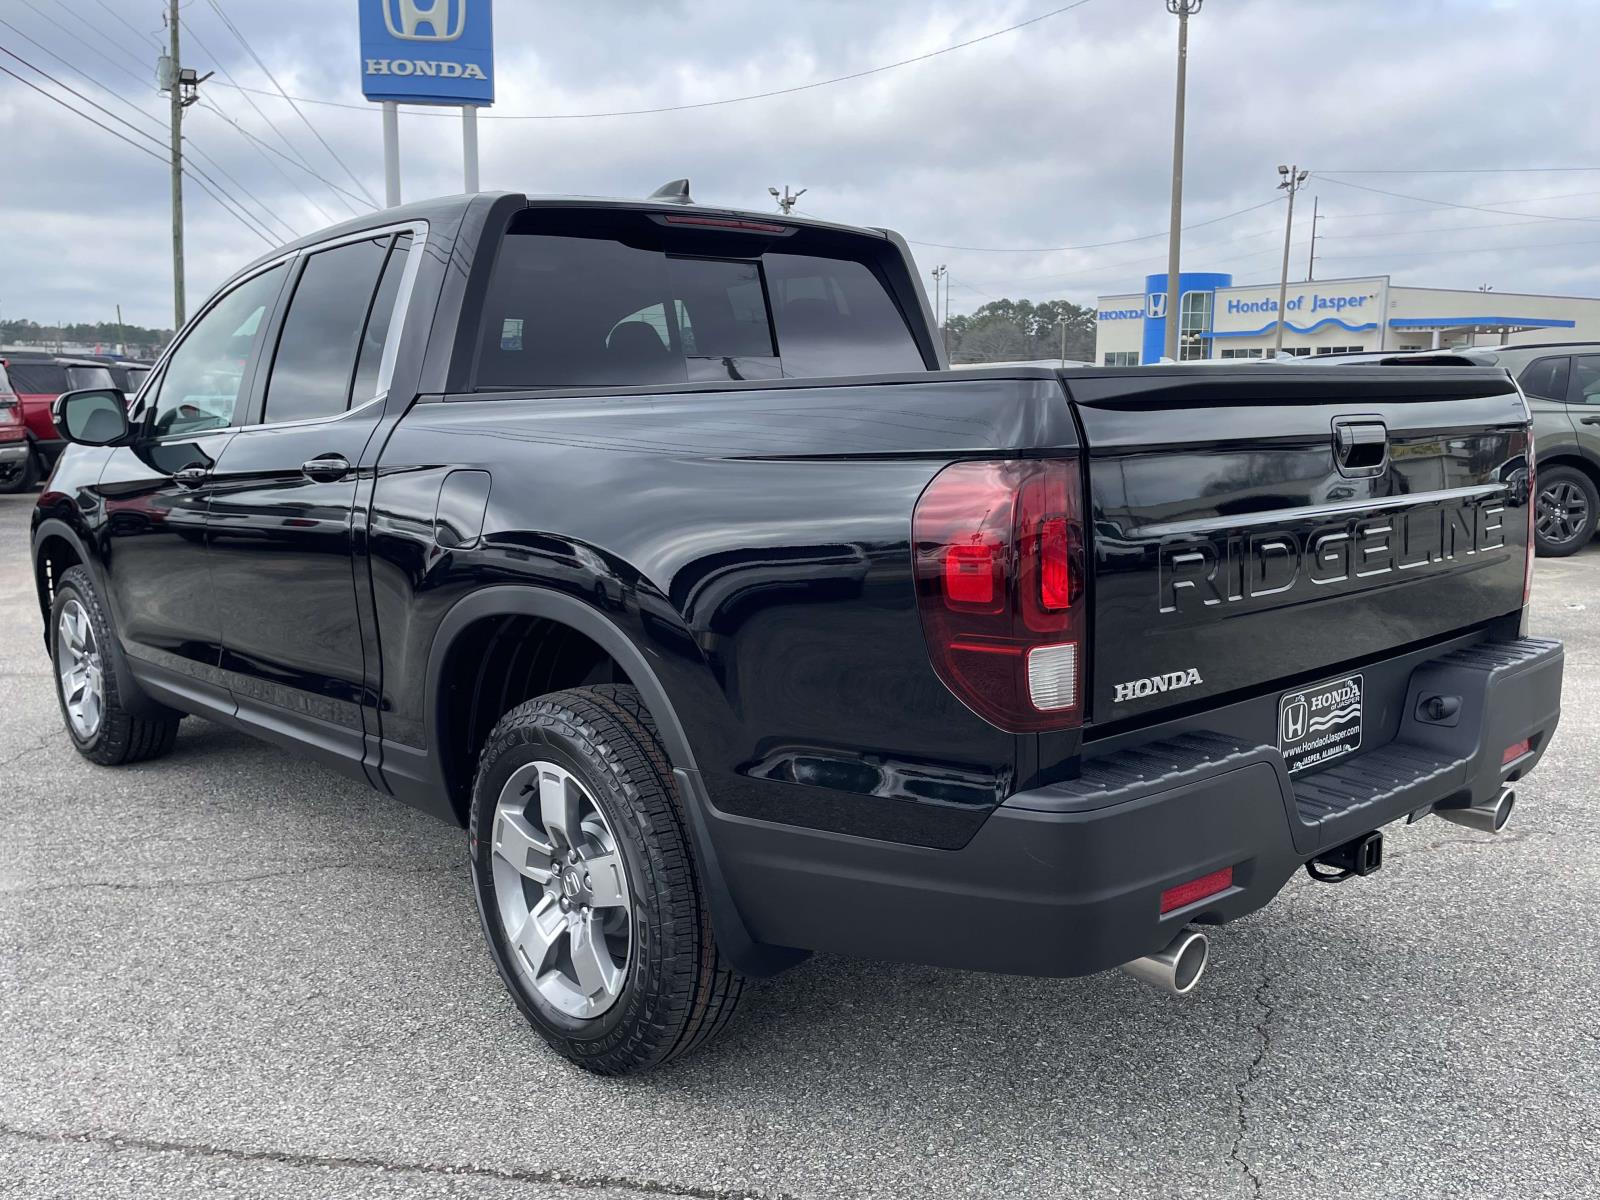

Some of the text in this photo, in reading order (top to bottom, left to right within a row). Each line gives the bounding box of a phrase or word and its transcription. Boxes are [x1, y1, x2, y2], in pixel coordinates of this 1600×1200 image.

[366, 59, 487, 80] HONDA
[1228, 295, 1366, 313] Honda of Jasper
[1158, 506, 1506, 613] RIDGELINE
[1113, 668, 1203, 703] HONDA
[1311, 684, 1360, 710] HONDA
[1337, 696, 1360, 708] JASPER
[1283, 725, 1359, 758] www.HondaofJasper.com
[1322, 744, 1342, 757] ALABAMA
